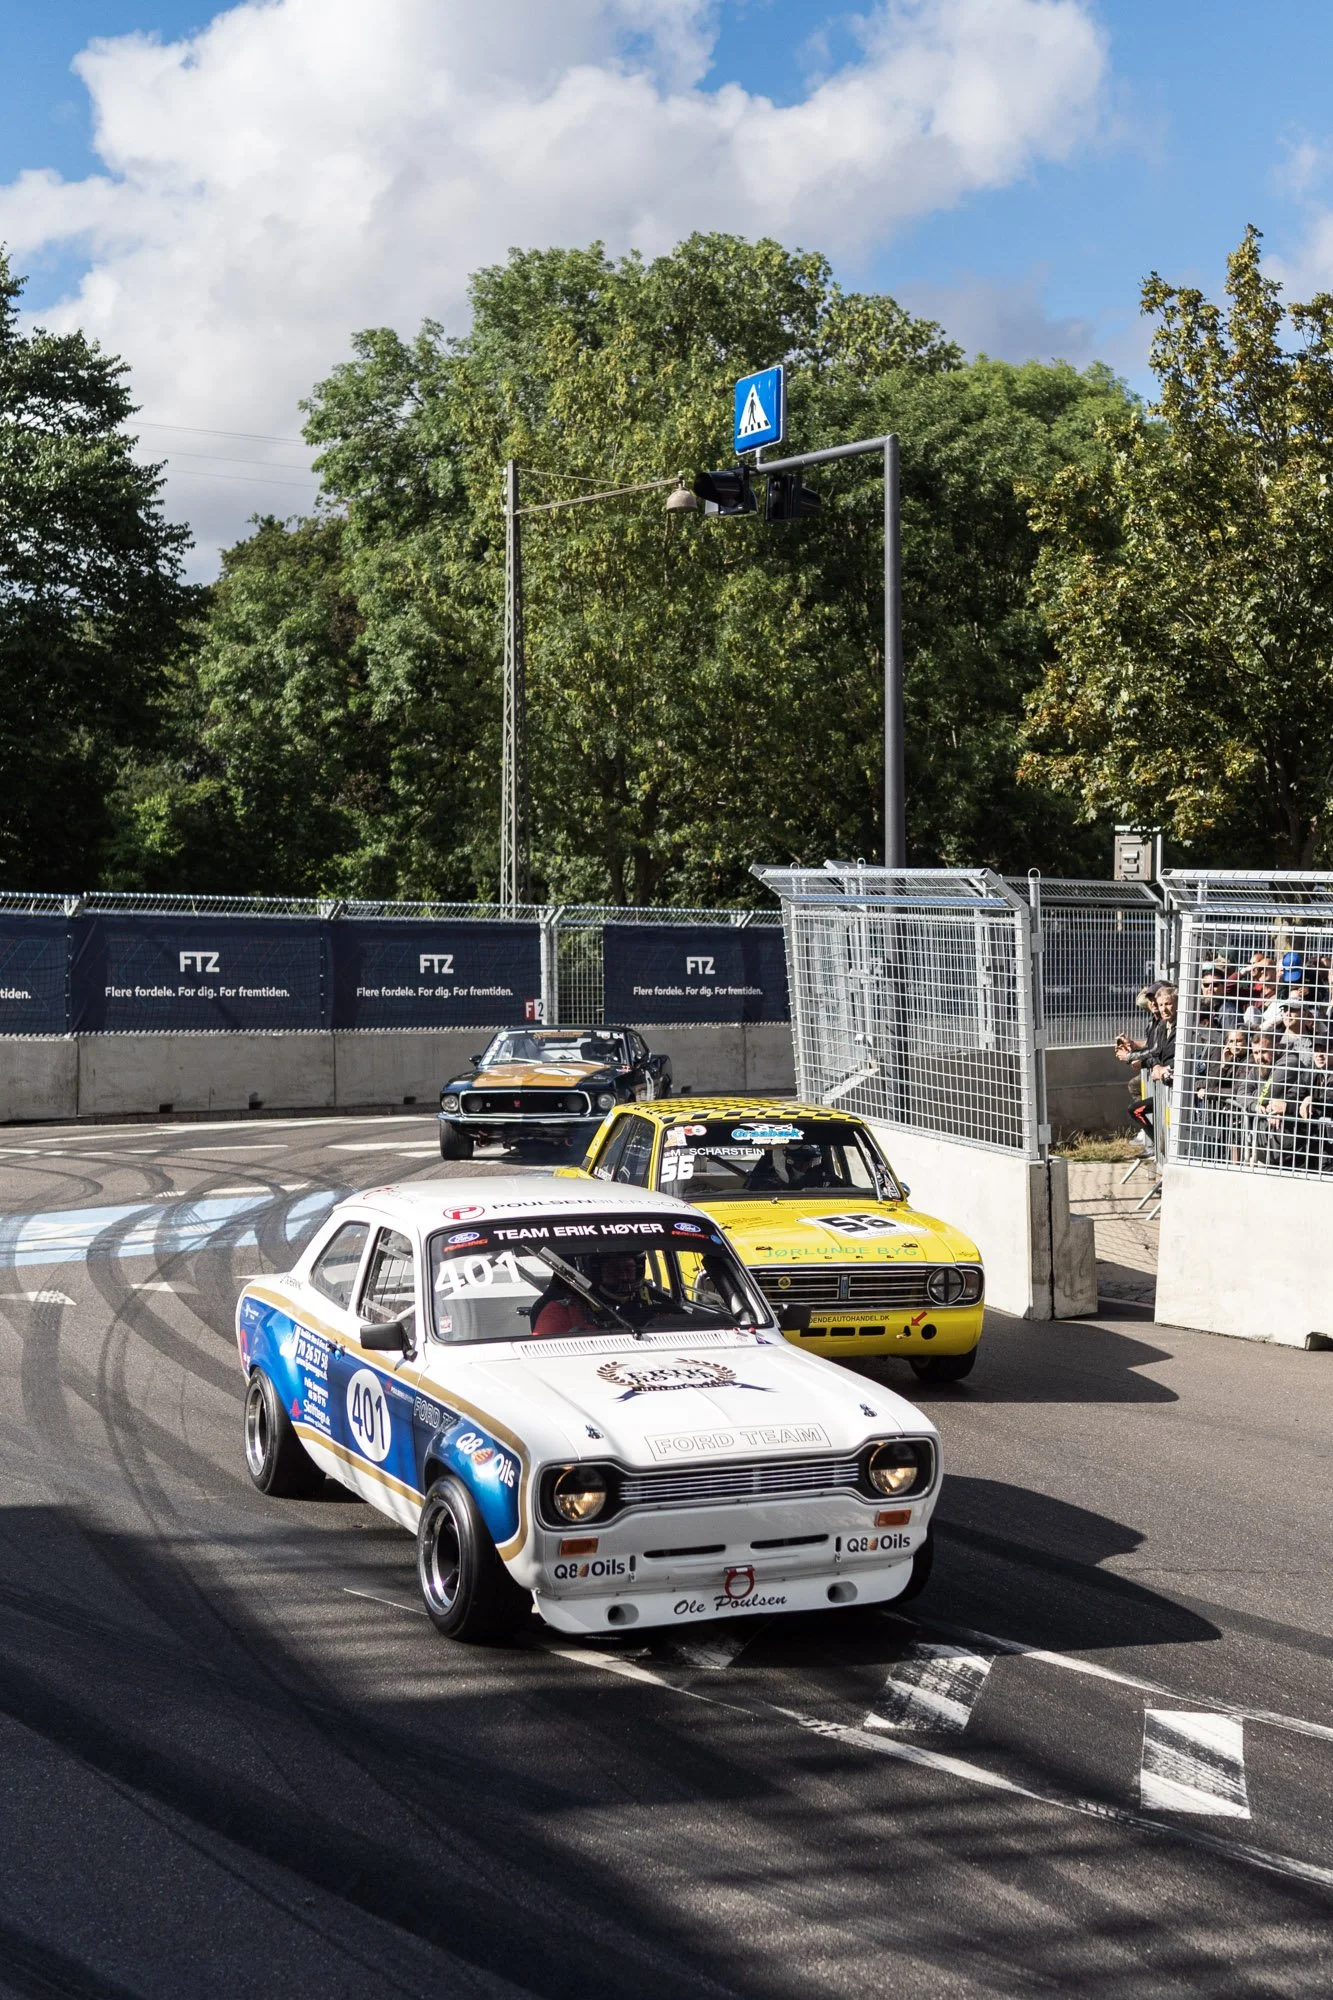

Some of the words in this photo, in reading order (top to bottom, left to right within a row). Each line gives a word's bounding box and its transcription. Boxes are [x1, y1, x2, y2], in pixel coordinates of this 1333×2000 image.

[179, 951, 220, 973] FTZ
[419, 954, 454, 974] FTZ
[686, 956, 716, 975] FTZ
[105, 986, 132, 998] Flere
[134, 986, 176, 998] fordele.
[178, 986, 195, 998] For
[197, 986, 217, 999] dig.
[219, 986, 236, 998] For
[238, 985, 290, 998] fremtiden.
[356, 987, 379, 997] Flere
[381, 986, 416, 997] fordele.
[418, 987, 434, 997] For
[435, 986, 451, 998] dig.
[453, 986, 469, 997] For
[469, 986, 513, 997] fremtiden.
[633, 986, 653, 996] Flere
[654, 986, 684, 996] fordele.
[685, 986, 699, 996] For
[700, 986, 713, 997] dig.
[714, 986, 727, 996] For
[727, 986, 763, 996] fremtiden.
[525, 1001, 534, 1018] F
[537, 1002, 544, 1017] 2
[689, 1147, 765, 1157] SCHARSTEIN
[660, 1155, 695, 1183] 56
[493, 1227, 550, 1240] TEAM
[553, 1225, 598, 1237] ERIK
[600, 1223, 665, 1234] HØYER
[764, 1246, 870, 1258] JØRLUNDE
[877, 1247, 917, 1256] BYG
[434, 1251, 523, 1294] 401
[352, 1382, 385, 1450] 401
[414, 1396, 440, 1429] FORD
[654, 1433, 735, 1454] FORD
[740, 1426, 822, 1446] TEAM
[456, 1432, 484, 1455] Q8
[491, 1453, 516, 1488] Oils
[847, 1537, 868, 1552] Q8
[880, 1533, 911, 1549] Oils
[554, 1563, 578, 1579] Q8
[591, 1558, 625, 1577] Oils
[673, 1599, 706, 1615] Ole
[713, 1593, 788, 1612] Poulsen
